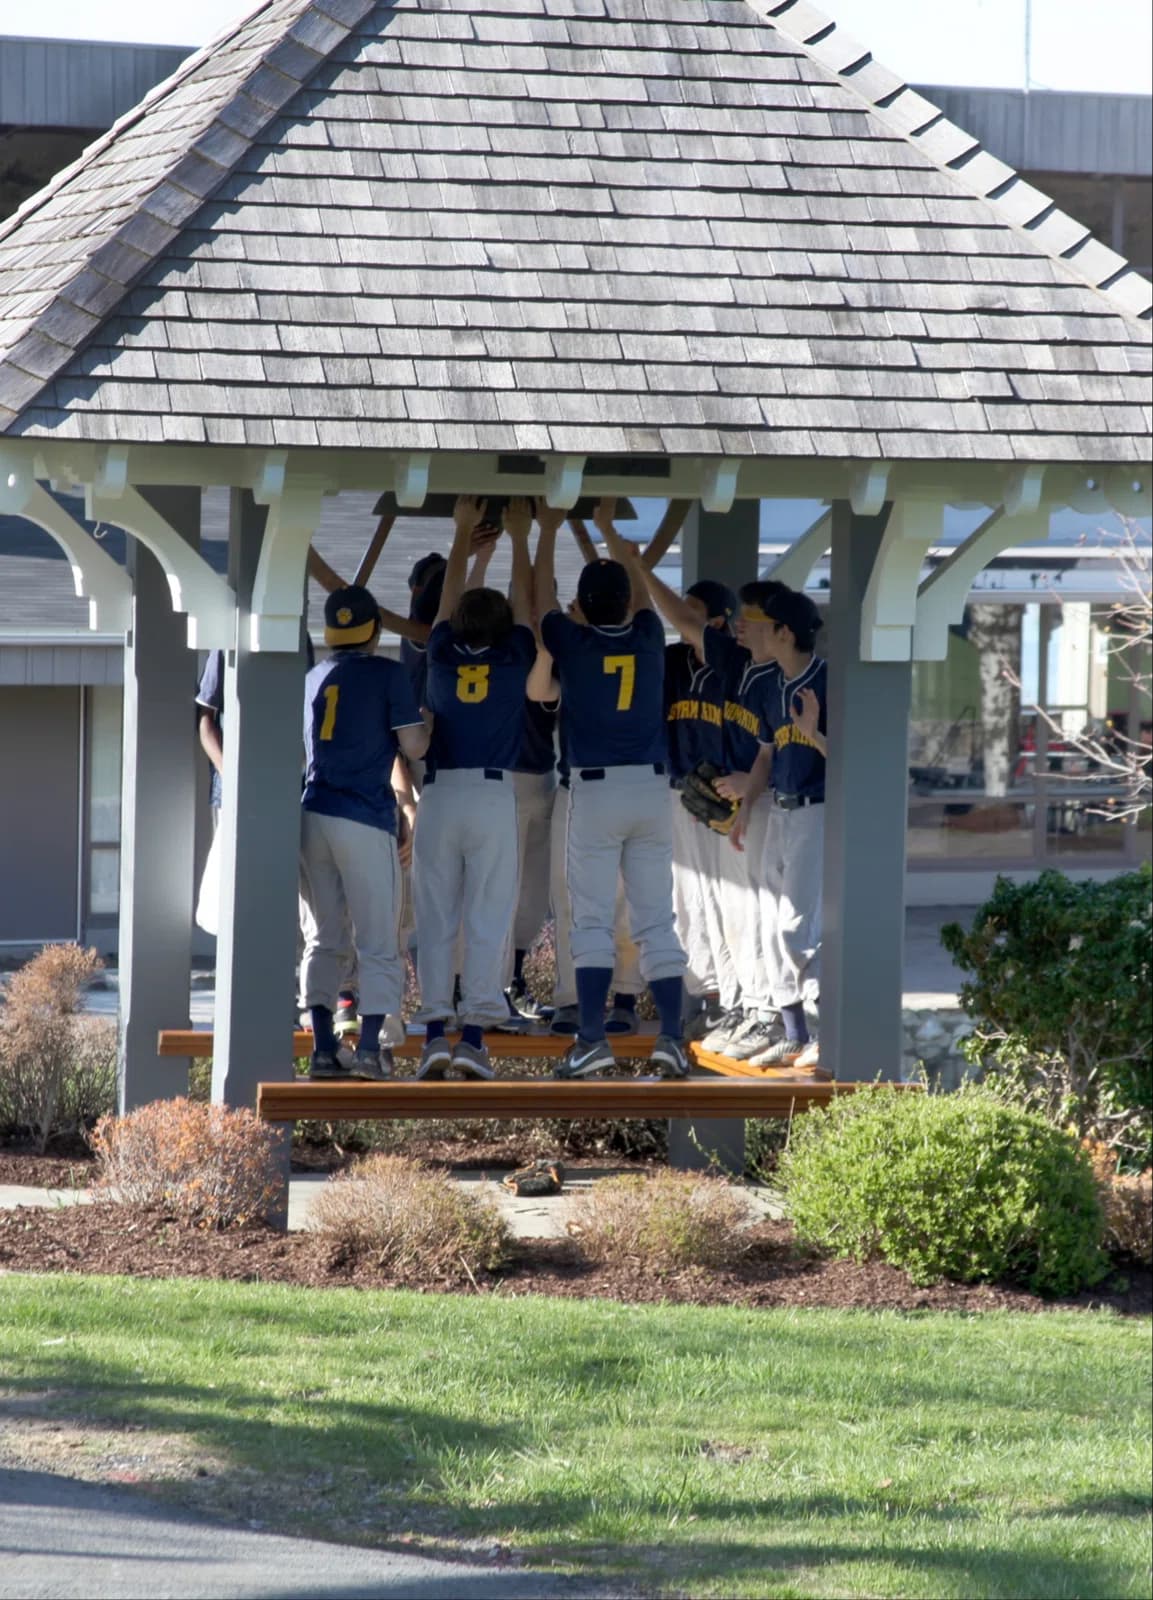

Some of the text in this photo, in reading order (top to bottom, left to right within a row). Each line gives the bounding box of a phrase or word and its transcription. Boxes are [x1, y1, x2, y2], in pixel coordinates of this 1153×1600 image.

[456, 664, 490, 704] 8
[603, 654, 636, 711] 7
[319, 685, 340, 741] 1
